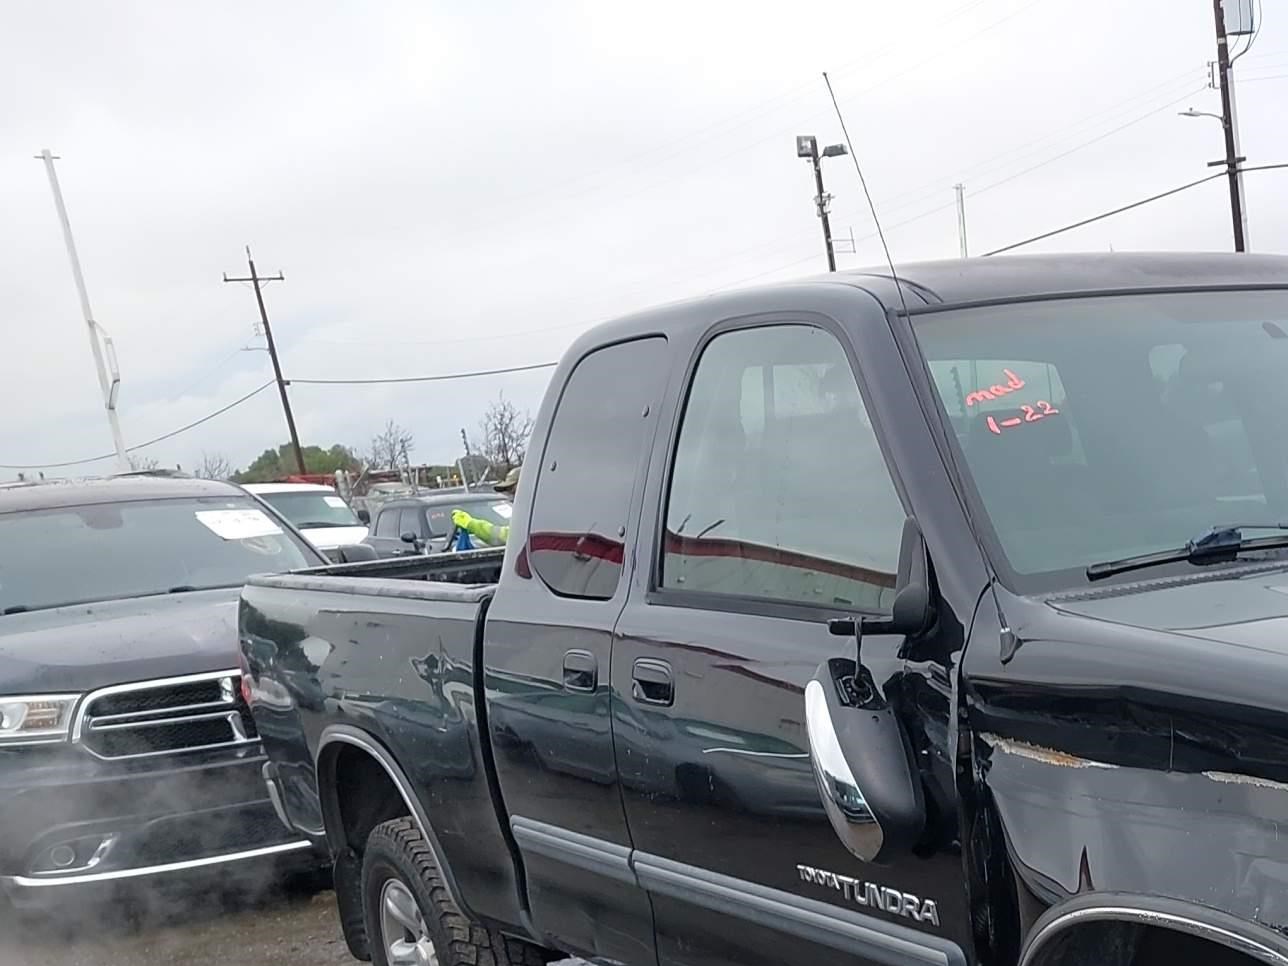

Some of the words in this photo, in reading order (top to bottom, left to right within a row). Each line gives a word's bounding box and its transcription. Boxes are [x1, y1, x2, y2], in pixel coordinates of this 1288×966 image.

[986, 400, 1060, 435] 1-22
[796, 864, 840, 890] TOYOTA
[838, 875, 941, 927] TUNDRA
